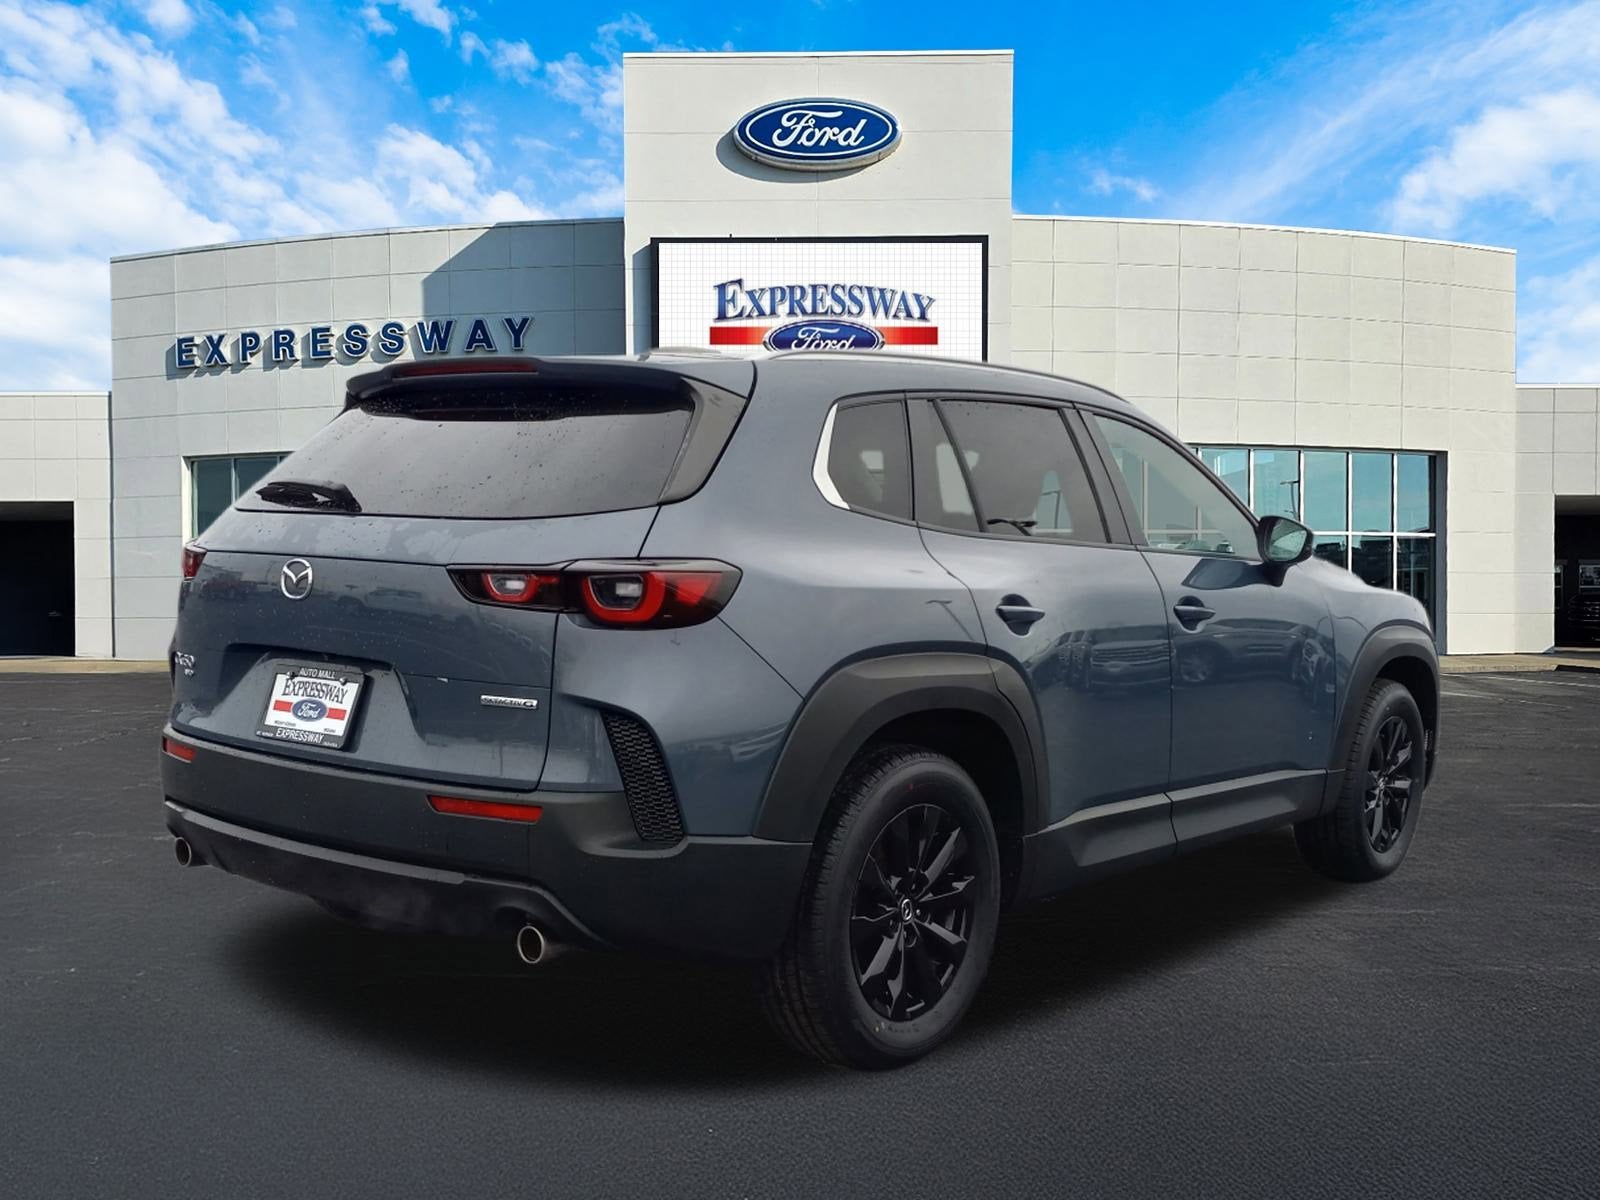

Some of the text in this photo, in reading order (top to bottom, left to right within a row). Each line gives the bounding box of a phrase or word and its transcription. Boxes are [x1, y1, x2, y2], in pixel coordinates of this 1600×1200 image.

[772, 110, 866, 147] Ford
[713, 278, 936, 322] EXPRESSWAY
[175, 315, 534, 369] EXPRESSWAY
[791, 326, 857, 350] Ford
[299, 667, 337, 679] AUTO MALL
[281, 679, 348, 704] EXPRESSWAY
[297, 702, 321, 718] Ford
[275, 728, 325, 744] EXPRESSWAY
